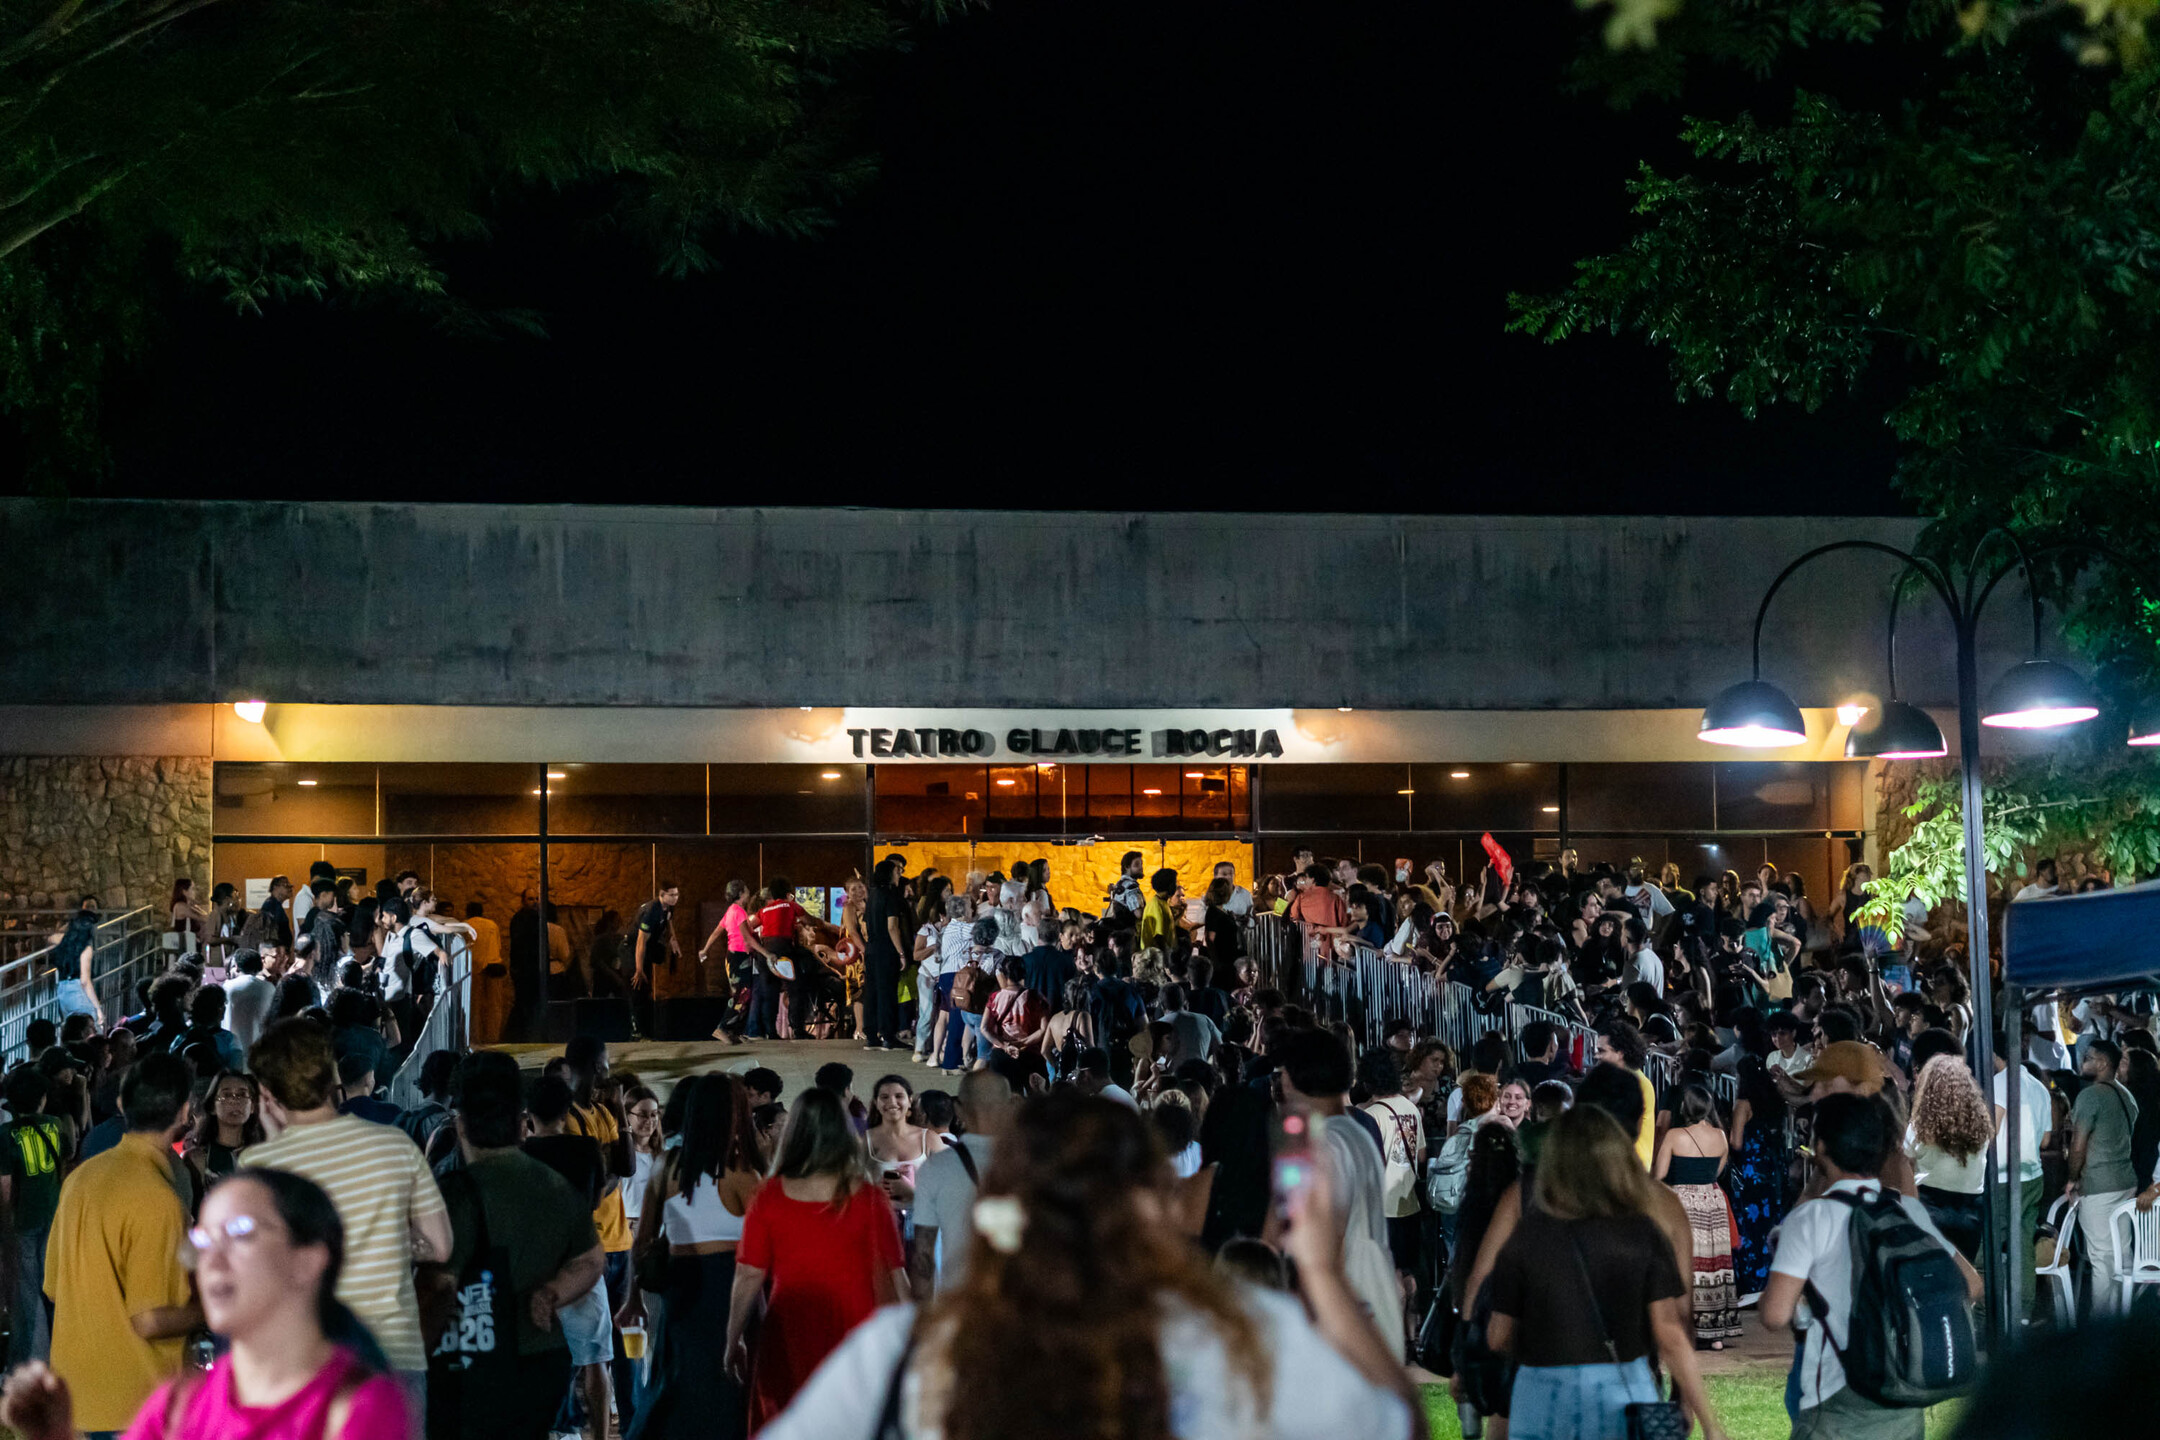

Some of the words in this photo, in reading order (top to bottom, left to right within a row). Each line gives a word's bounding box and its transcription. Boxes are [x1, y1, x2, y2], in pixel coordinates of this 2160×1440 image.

[847, 727, 990, 758] TEATRO
[1006, 727, 1142, 757] GLAUCE
[1160, 728, 1284, 758] ROCHA
[11, 1123, 60, 1177] 10
[432, 1314, 495, 1356] 026
